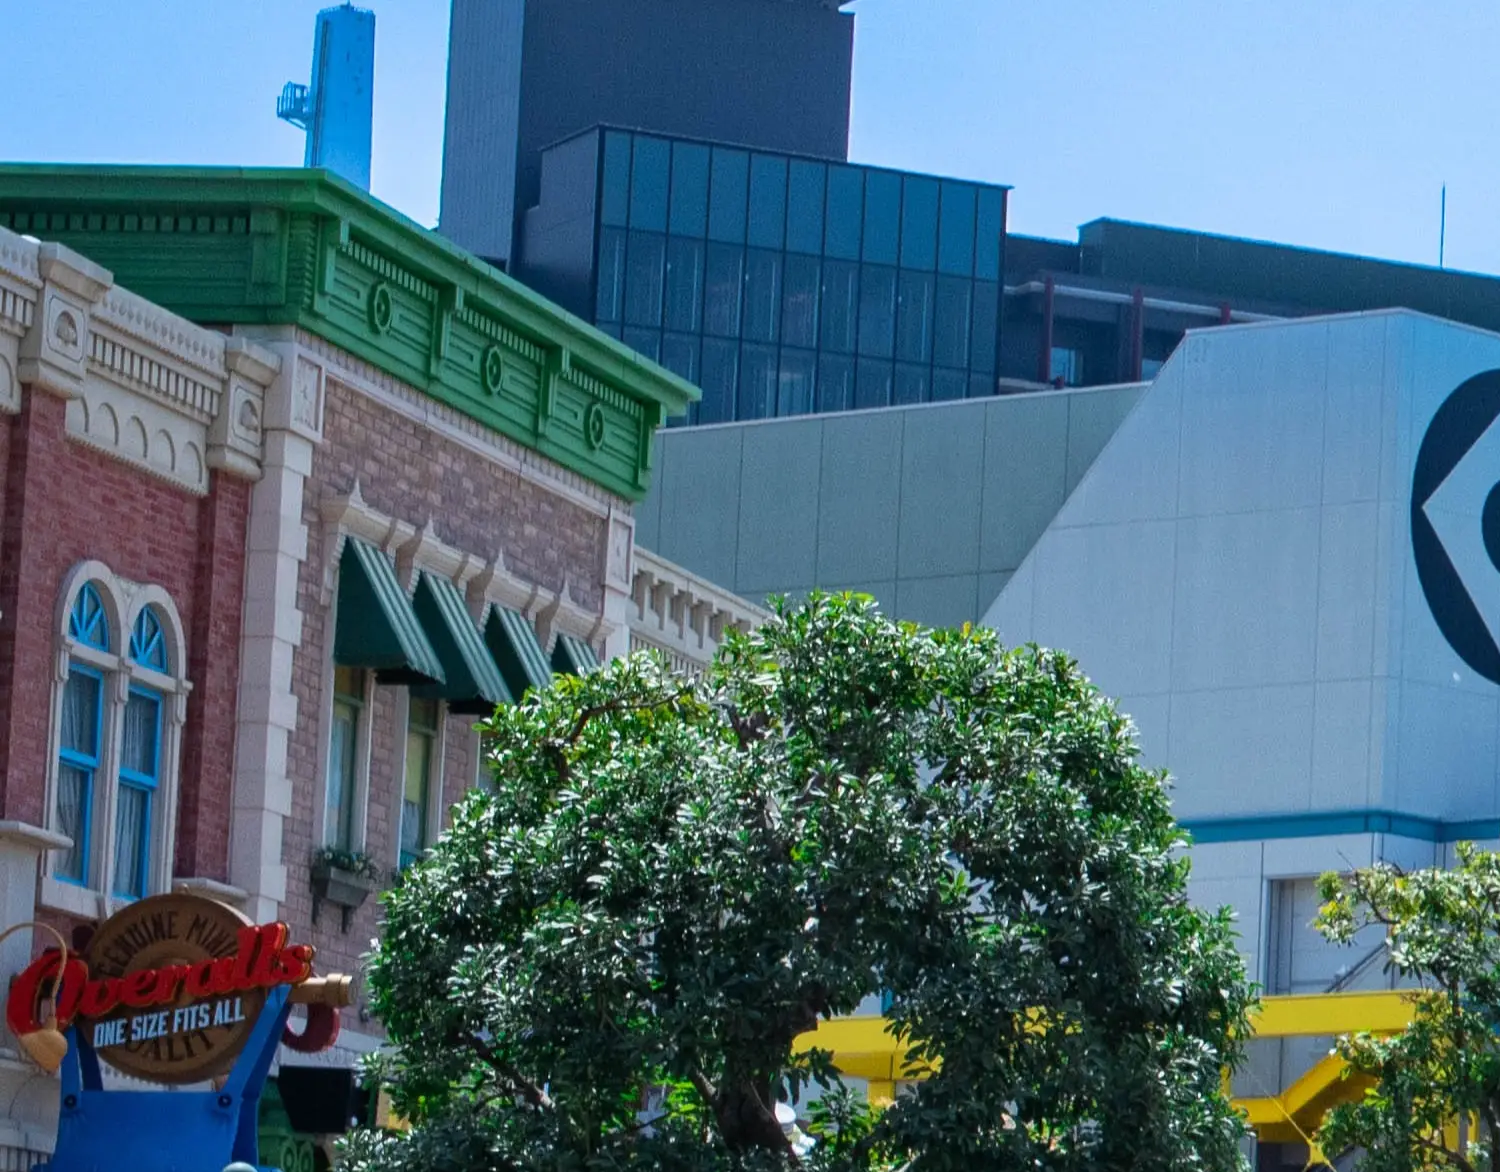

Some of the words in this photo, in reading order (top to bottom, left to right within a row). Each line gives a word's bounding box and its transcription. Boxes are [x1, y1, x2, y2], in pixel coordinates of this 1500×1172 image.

[7, 921, 314, 1036] Overalls
[93, 1017, 128, 1048] ONE
[131, 1010, 171, 1042] SIZE
[173, 1004, 211, 1034] FITS
[213, 997, 246, 1027] ALL
